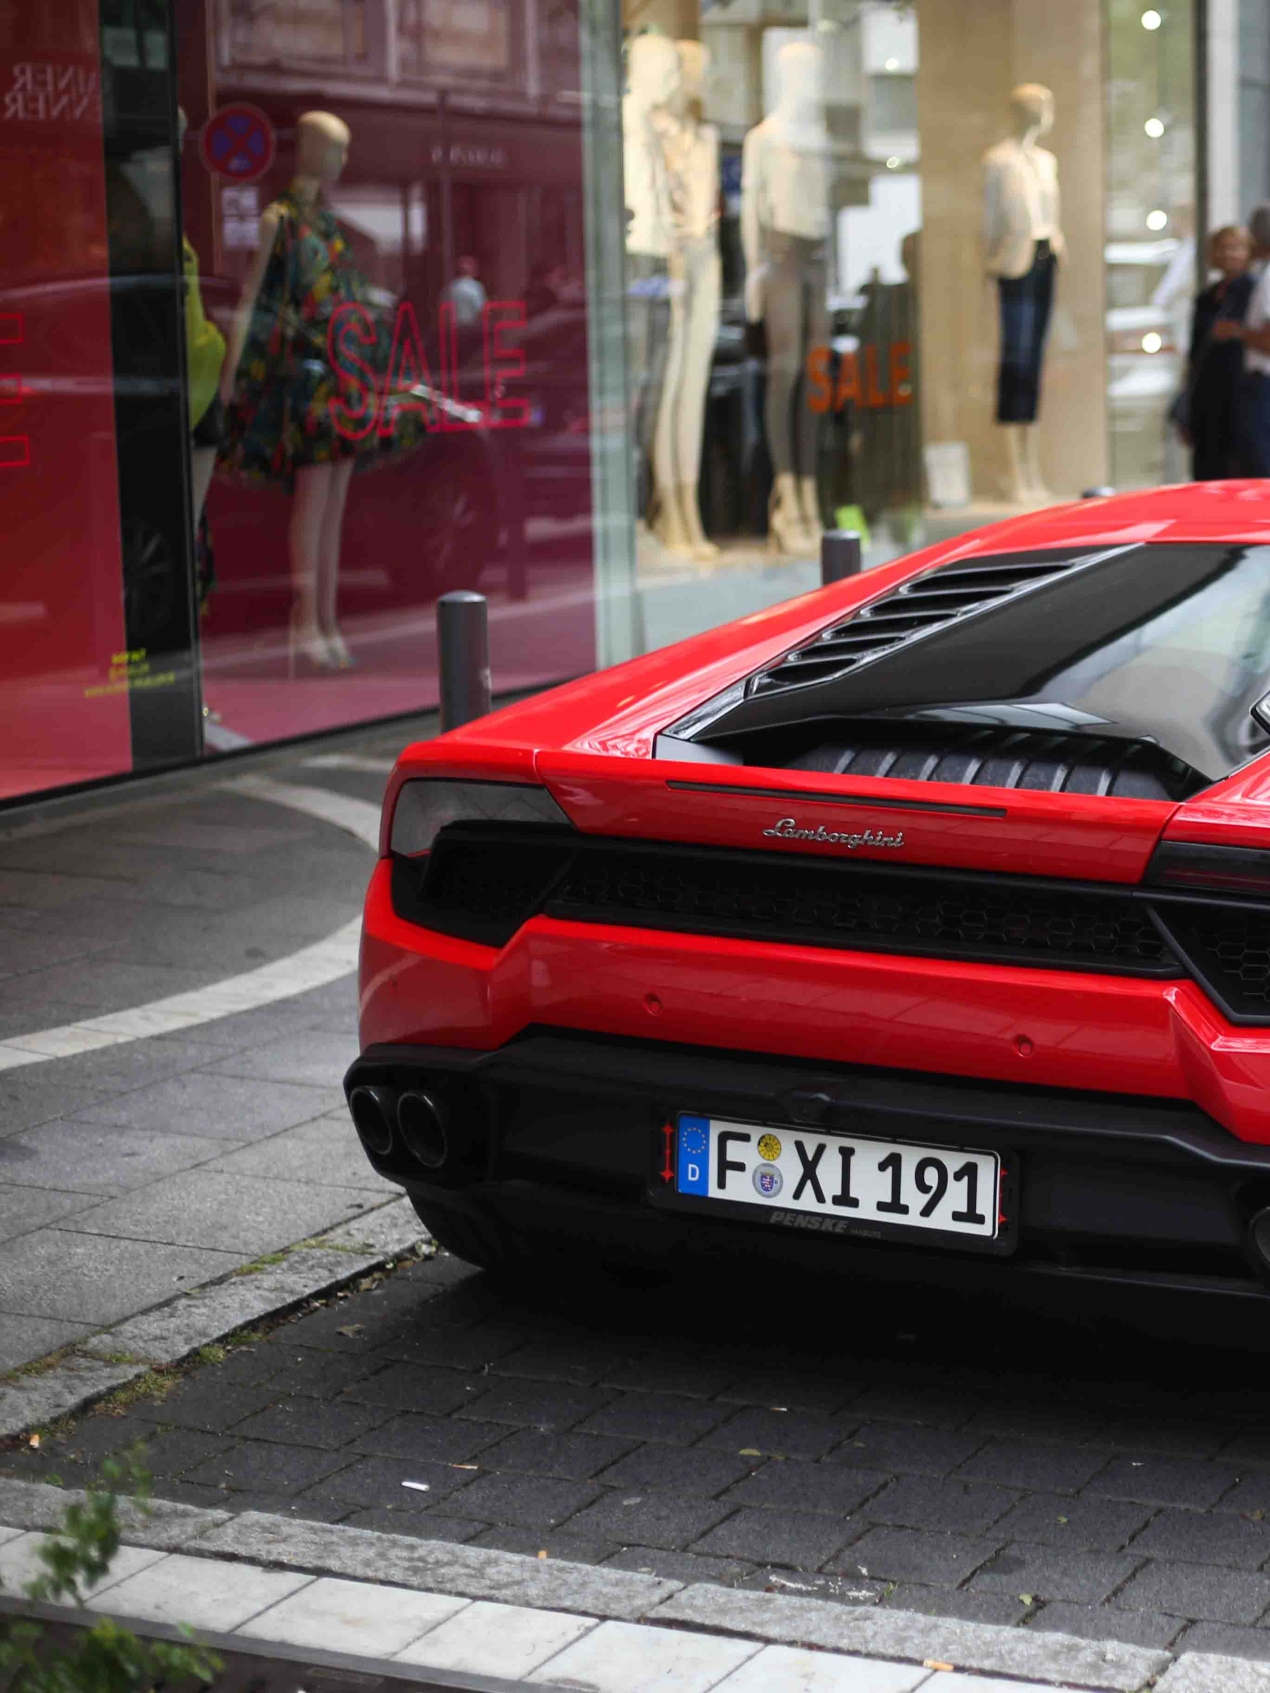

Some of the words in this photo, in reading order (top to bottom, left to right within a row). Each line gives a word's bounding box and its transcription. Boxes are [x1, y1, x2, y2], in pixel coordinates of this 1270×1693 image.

[327, 301, 530, 440] SALE
[806, 341, 914, 415] SALE
[762, 818, 904, 849] Lamborghini
[688, 1164, 699, 1181] D
[717, 1130, 751, 1190] F
[792, 1140, 860, 1209] XI
[876, 1152, 985, 1225] 191
[769, 1211, 849, 1233] PENSKE
